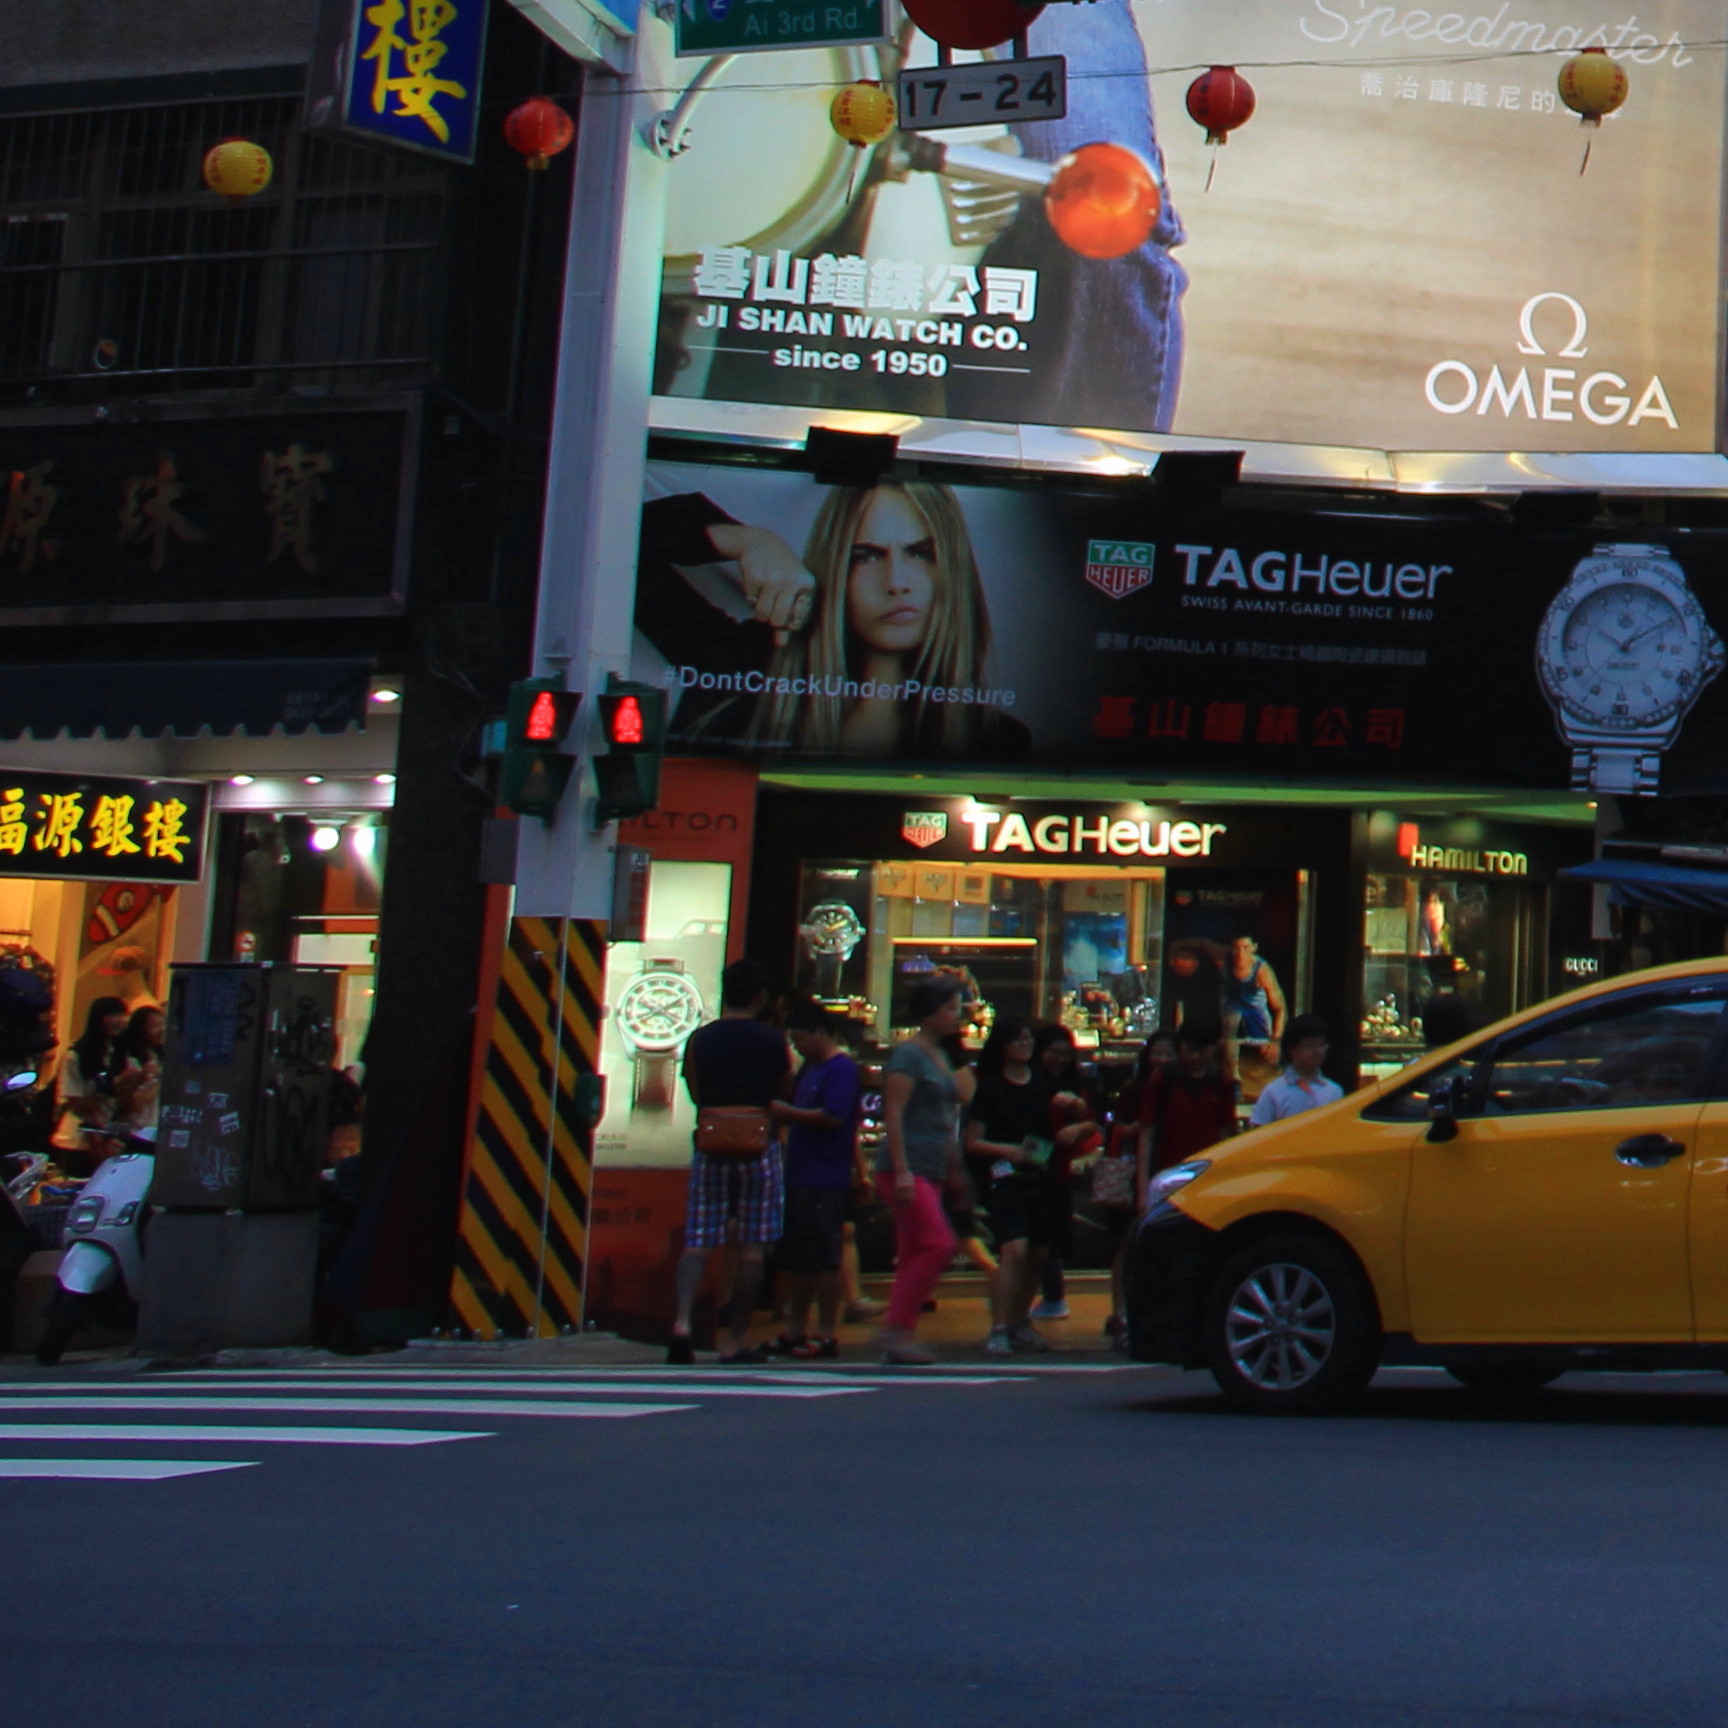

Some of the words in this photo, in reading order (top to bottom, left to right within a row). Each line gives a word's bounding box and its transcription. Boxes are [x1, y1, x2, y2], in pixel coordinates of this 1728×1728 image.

[743, 10, 770, 34] Ai
[777, 7, 817, 32] 3rd
[824, 4, 863, 29] Rd.
[696, 307, 729, 330] JI
[737, 306, 833, 337] SHAN
[842, 316, 963, 348] WATCH
[971, 325, 1029, 353] CO.
[773, 345, 861, 372] since
[869, 348, 947, 378] 1950
[1424, 359, 1680, 430] OMEGA
[1097, 543, 1150, 563] TAG
[1088, 565, 1153, 594] HEUER
[1173, 543, 1454, 601] TAGHeuer
[1181, 595, 1225, 611] SWISS
[1233, 598, 1341, 617] AVANT-GARDE
[1348, 604, 1395, 620] SINCE
[1400, 607, 1435, 623] 1860
[663, 666, 1017, 708] #DontCrackUnderPressure
[0, 787, 193, 864] 福源銀樓
[905, 812, 947, 827] TAG
[961, 811, 1227, 857] TAGHeuer
[1410, 843, 1528, 875] HAMILTON
